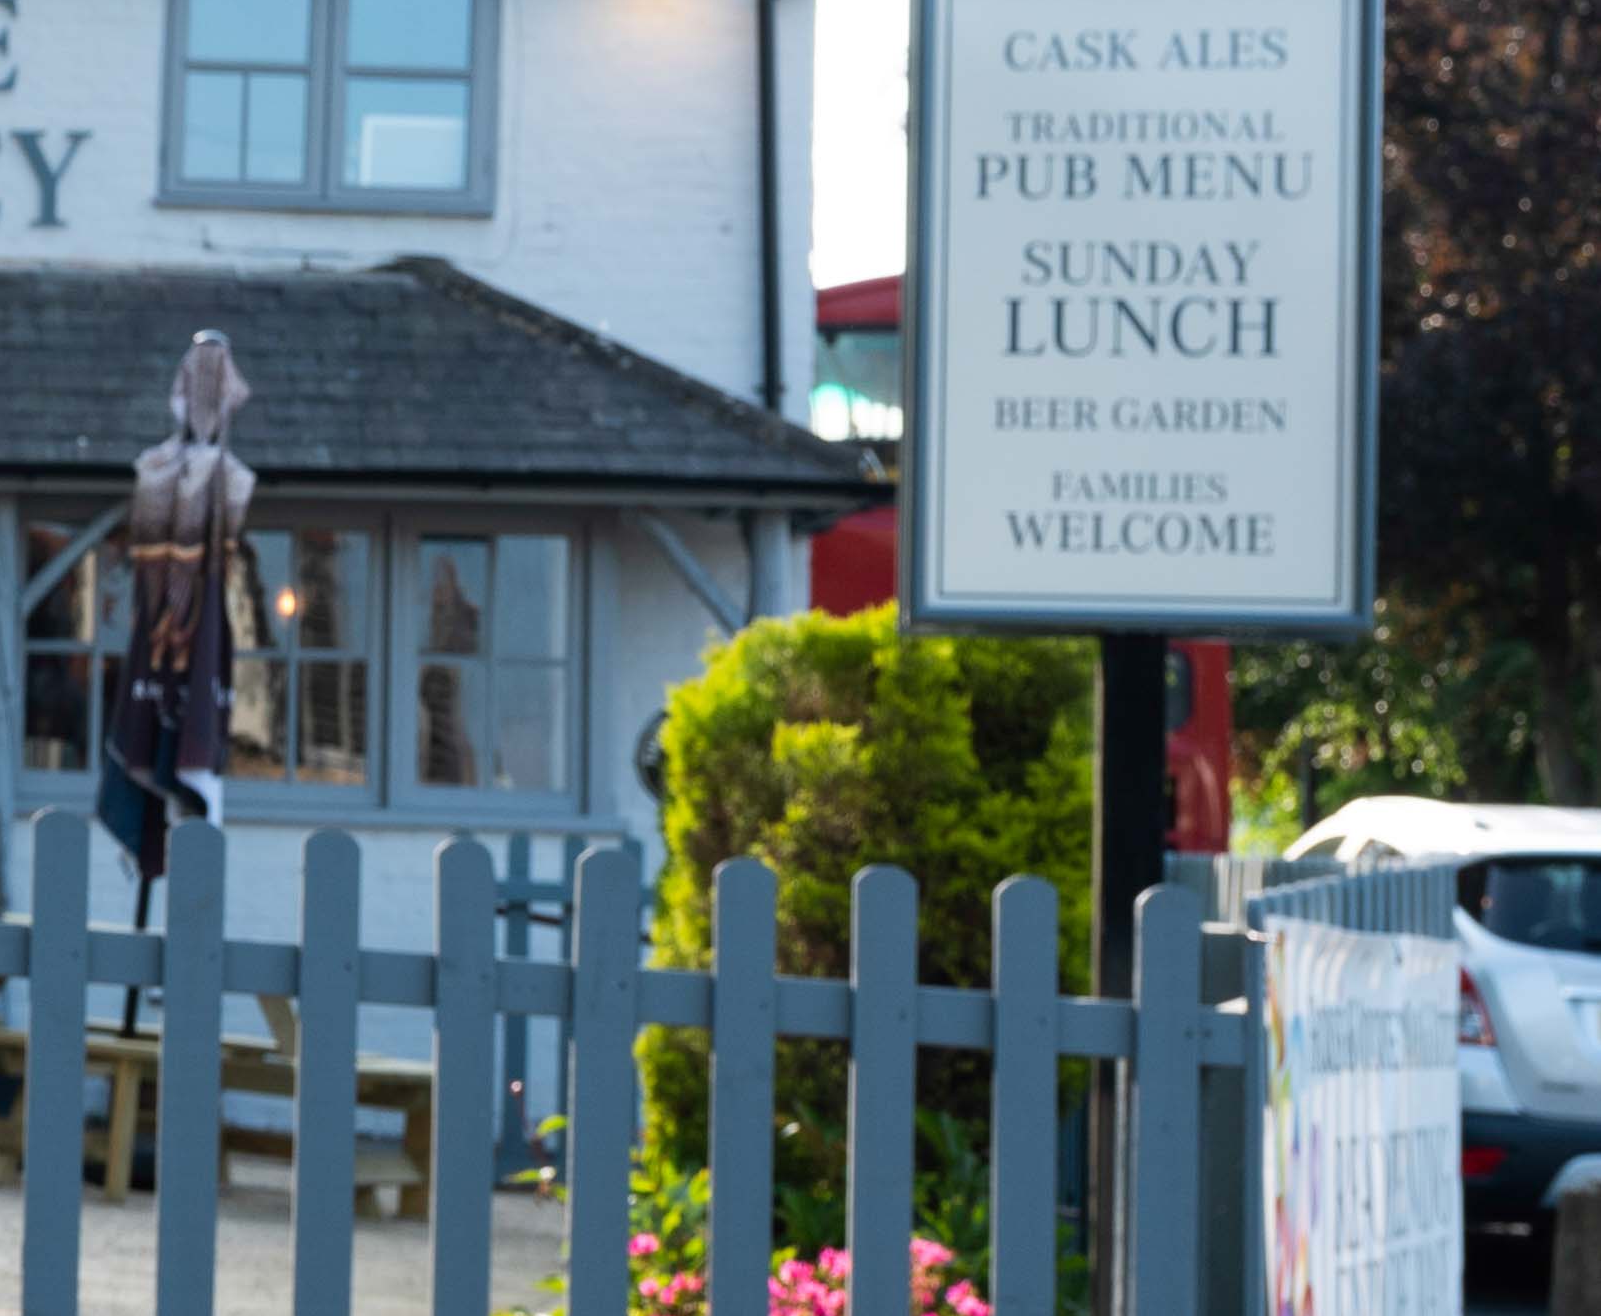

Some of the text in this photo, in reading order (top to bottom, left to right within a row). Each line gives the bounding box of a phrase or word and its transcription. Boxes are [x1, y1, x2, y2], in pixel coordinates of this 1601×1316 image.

[1003, 29, 1289, 73] CASK ALES
[1005, 110, 1284, 145] TRADITIONAL
[976, 151, 1313, 201] PUB MENU
[1021, 240, 1258, 287] SUNDAY
[1003, 296, 1279, 359] LUNCH
[994, 396, 1287, 434] BEER GARDEN
[1051, 470, 1228, 504] FAMILIES
[1006, 511, 1276, 557] WELCOME
